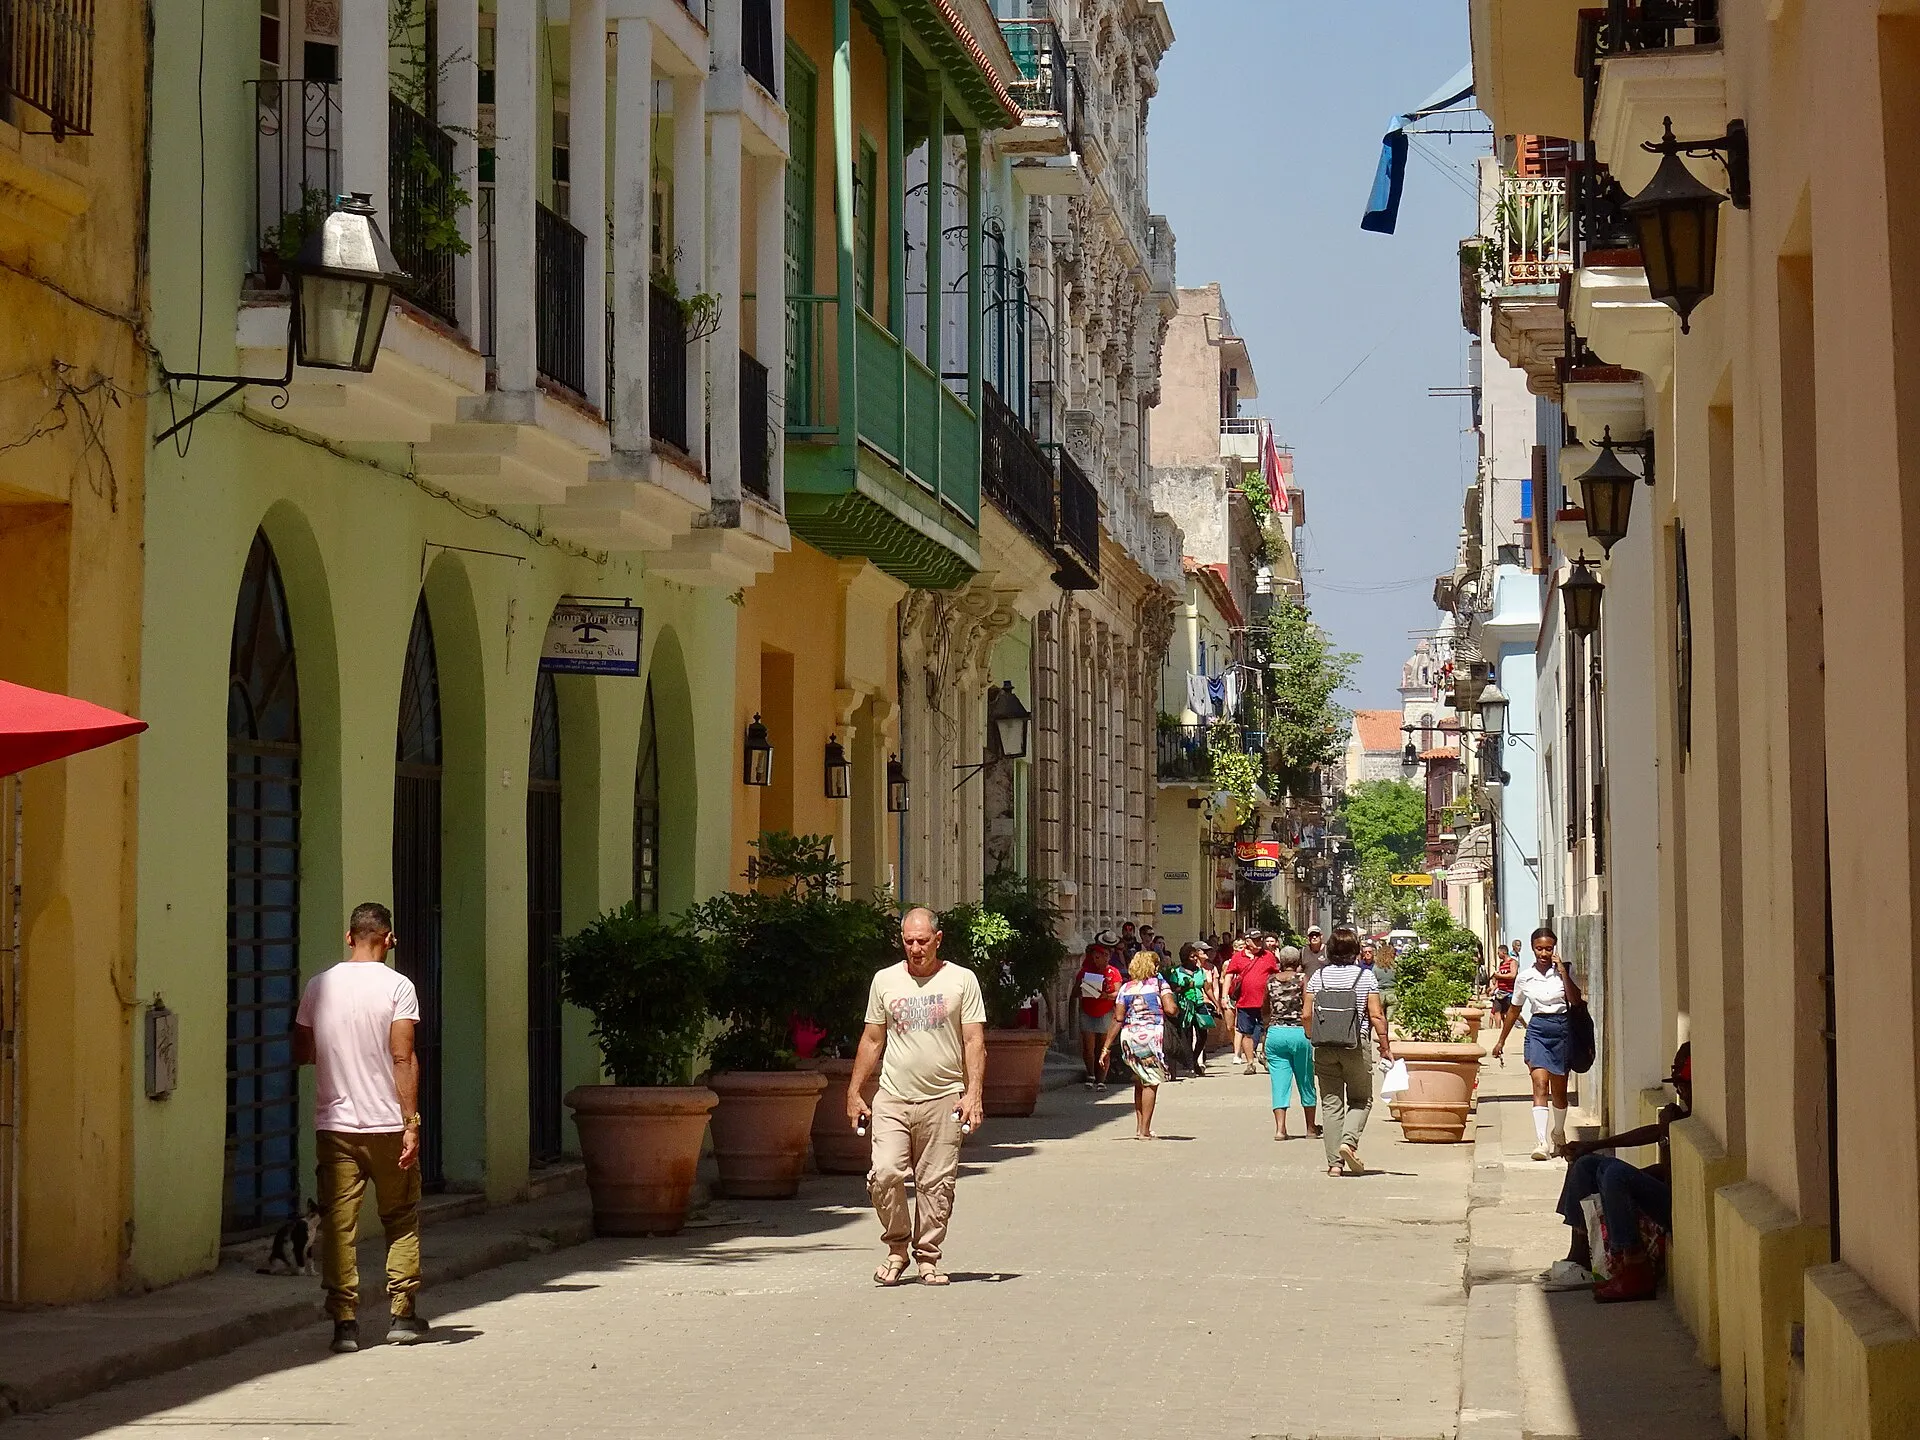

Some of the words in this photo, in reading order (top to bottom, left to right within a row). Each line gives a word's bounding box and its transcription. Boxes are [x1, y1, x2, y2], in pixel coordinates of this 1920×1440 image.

[585, 612, 604, 623] for
[607, 613, 636, 625] Rent
[597, 650, 603, 658] y
[889, 993, 943, 1012] COUTURE
